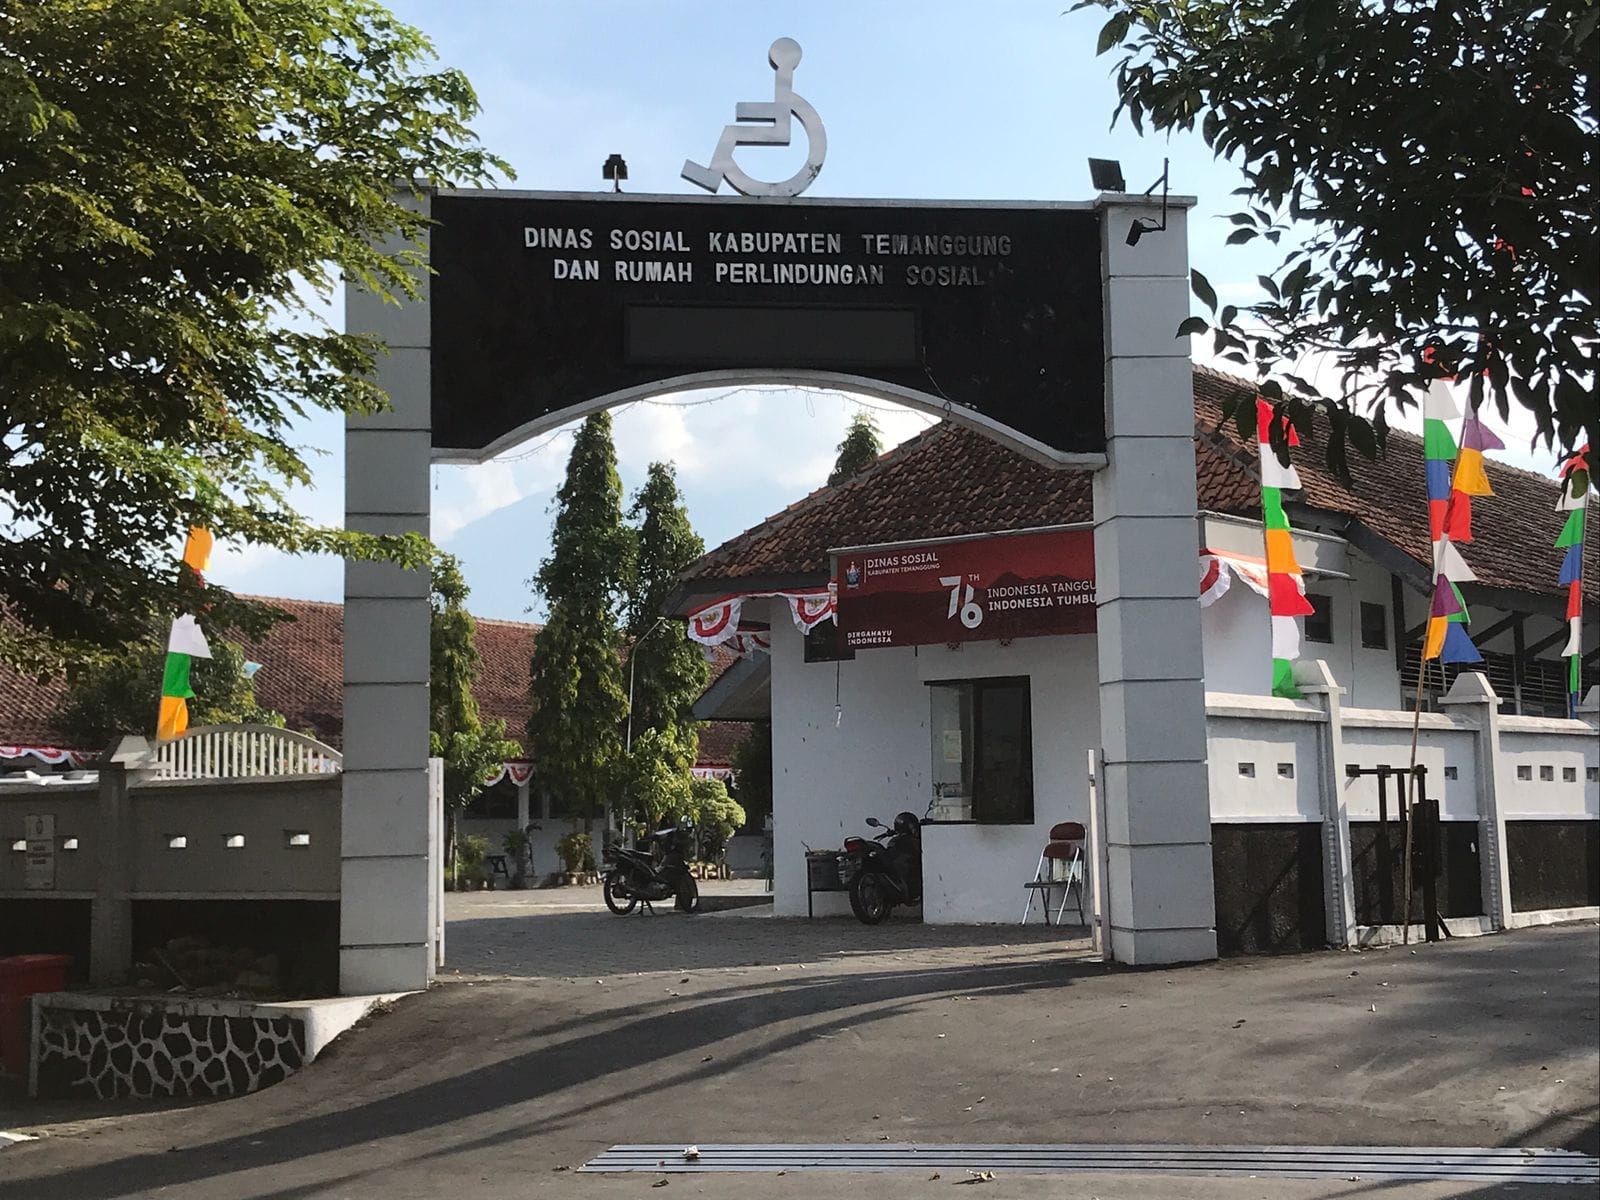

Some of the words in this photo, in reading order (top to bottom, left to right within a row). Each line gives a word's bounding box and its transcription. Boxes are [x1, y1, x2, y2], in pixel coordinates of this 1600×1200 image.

[524, 227, 593, 249] DINAS
[610, 229, 690, 252] SOSIAL
[709, 232, 841, 254] KABUPATEN
[861, 234, 1012, 256] TEMANGGUNG
[553, 259, 599, 280] DAN
[615, 261, 692, 282] RUMAH
[715, 263, 884, 285] PERLINDUNGAN
[906, 265, 985, 286] SOSIAL
[867, 557, 899, 569] DINAS
[901, 552, 939, 565] SOSIAL
[867, 567, 900, 576] KABUPATEN
[900, 563, 940, 573] TEMANGGUNG
[987, 584, 1049, 599] INDONESIA
[988, 597, 1054, 611] INDONESIA
[848, 637, 892, 646] INDONESIA
